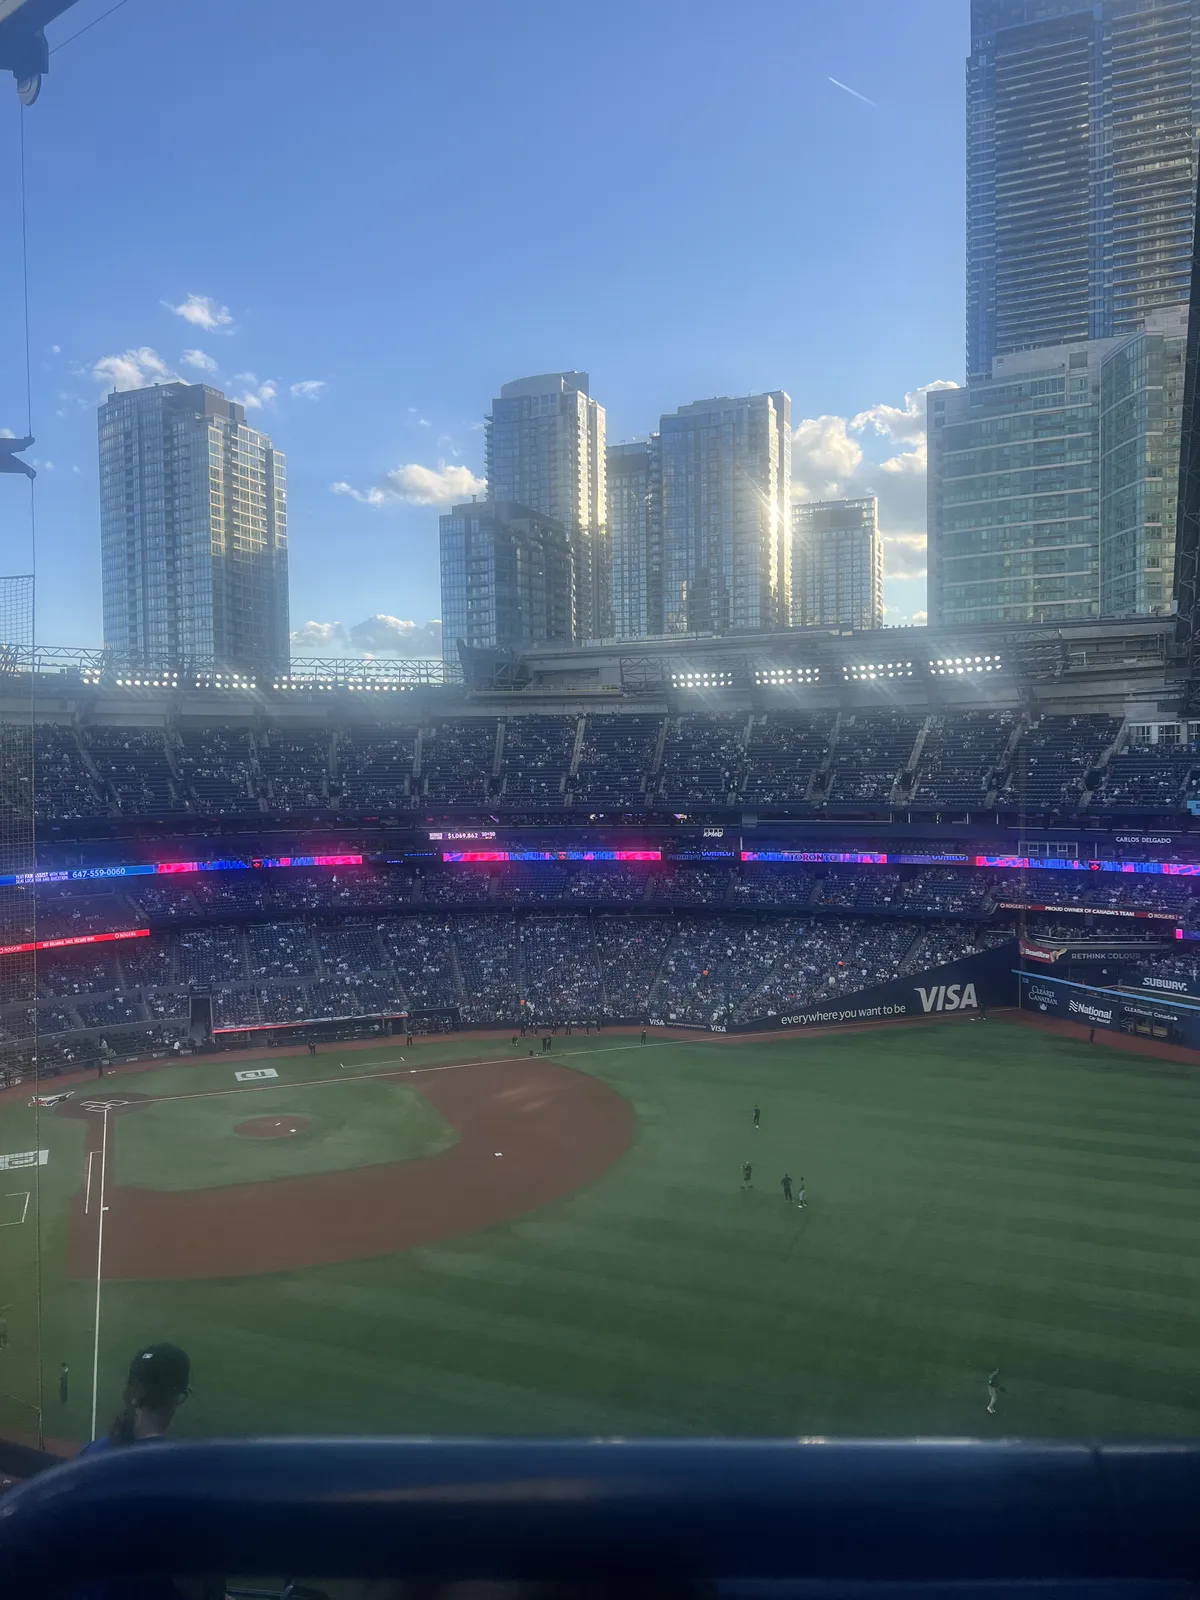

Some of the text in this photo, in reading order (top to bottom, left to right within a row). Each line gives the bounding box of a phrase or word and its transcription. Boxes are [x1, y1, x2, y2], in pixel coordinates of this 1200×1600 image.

[703, 828, 723, 837] KPMG
[790, 853, 837, 861] TORONTO
[72, 868, 126, 878] 647-559-0060
[1142, 977, 1187, 991] SUBWAY
[914, 983, 978, 1012] VISA
[1028, 991, 1058, 1005] CANADIAN
[781, 1004, 906, 1025] everywhere you want to be
[1078, 1003, 1112, 1019] National
[1096, 1016, 1111, 1024] Rental
[1154, 1012, 1173, 1020] Canada
[649, 1018, 665, 1026] VISA
[710, 1024, 727, 1033] VISA
